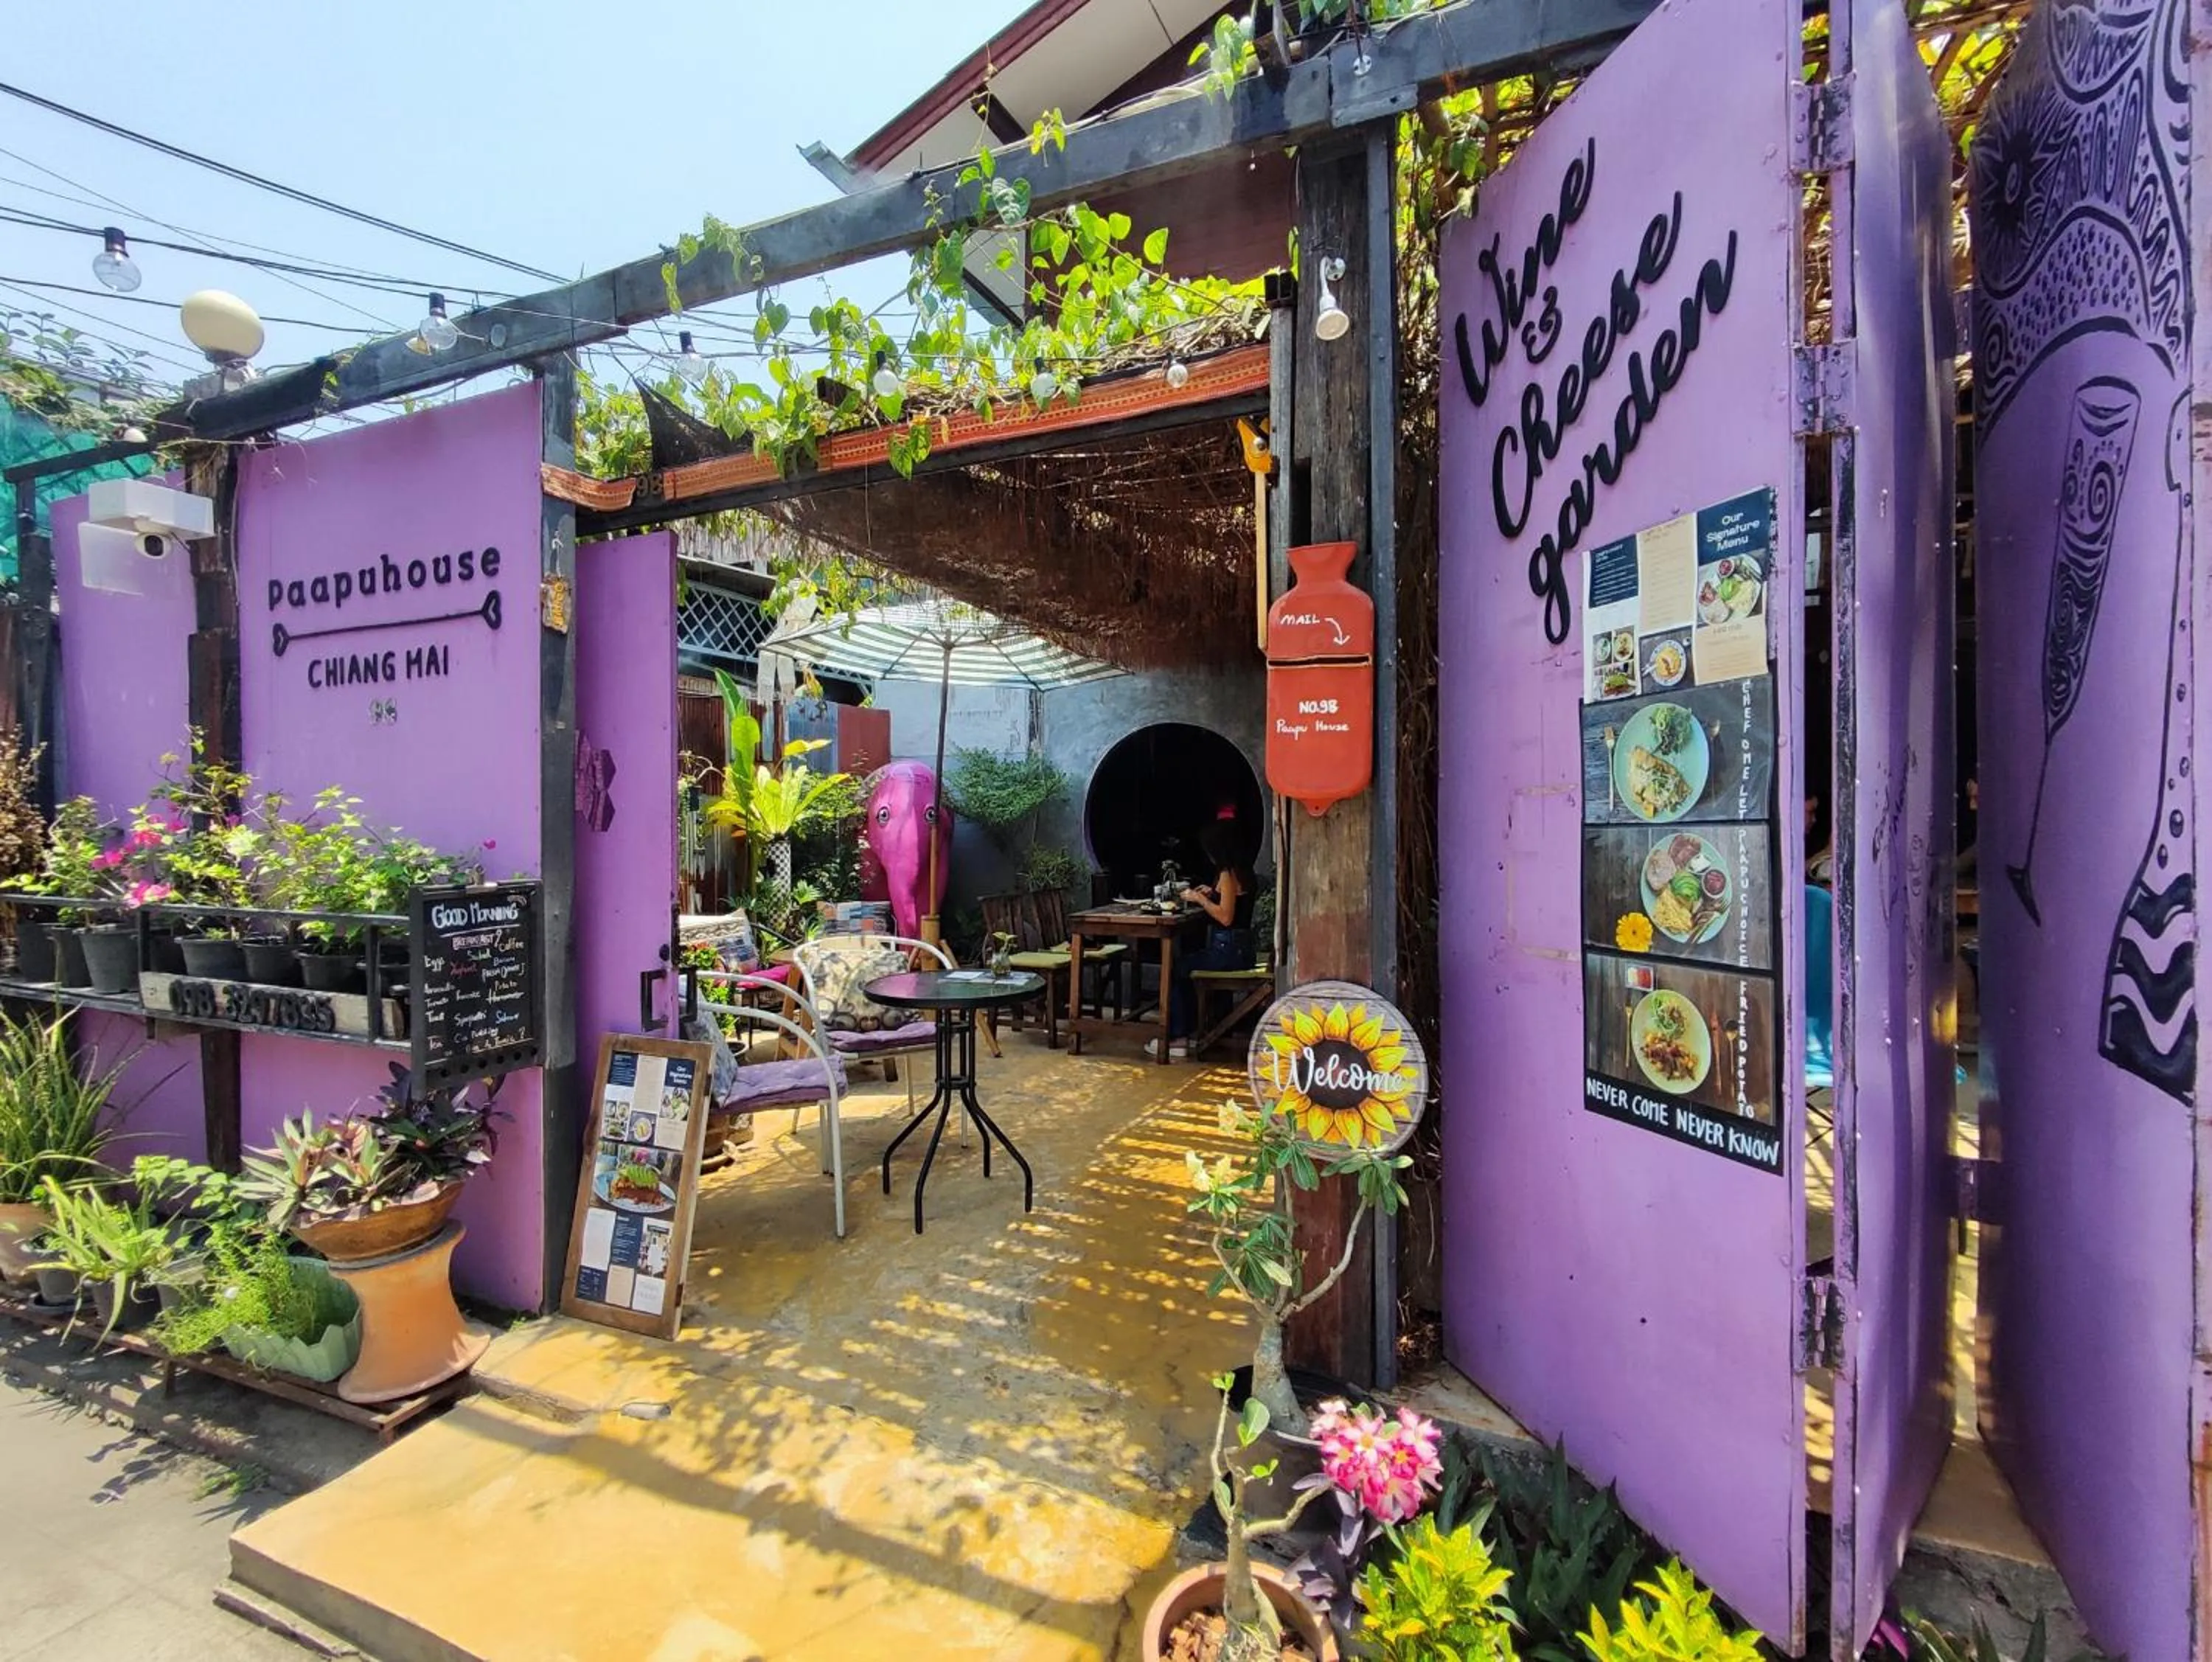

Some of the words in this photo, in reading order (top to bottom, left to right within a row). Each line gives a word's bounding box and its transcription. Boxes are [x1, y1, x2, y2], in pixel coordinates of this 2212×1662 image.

[1454, 137, 1595, 408] Wine
[1521, 285, 1562, 365] &
[1492, 190, 1682, 540] Cheese
[1528, 229, 1737, 646] garden
[1706, 520, 1760, 543] Signature
[1717, 535, 1748, 552] Menu
[1722, 512, 1744, 525] Our
[268, 546, 501, 612] paapuhouse
[1280, 614, 1321, 625] MAIL
[307, 651, 396, 689] CHIANG
[406, 644, 449, 680] MAI
[1315, 720, 1350, 732] House
[1741, 679, 1753, 734] CHEF
[1738, 830, 1750, 889] PAAPU
[1739, 893, 1750, 967] CHOICE
[1738, 980, 1748, 1052] FRIED
[1263, 1046, 1402, 1095] Welcome
[1586, 1077, 1629, 1109] NEVER
[1632, 1095, 1669, 1126] COME
[1676, 1108, 1724, 1148] NEVER
[1728, 1126, 1779, 1166] KNOW
